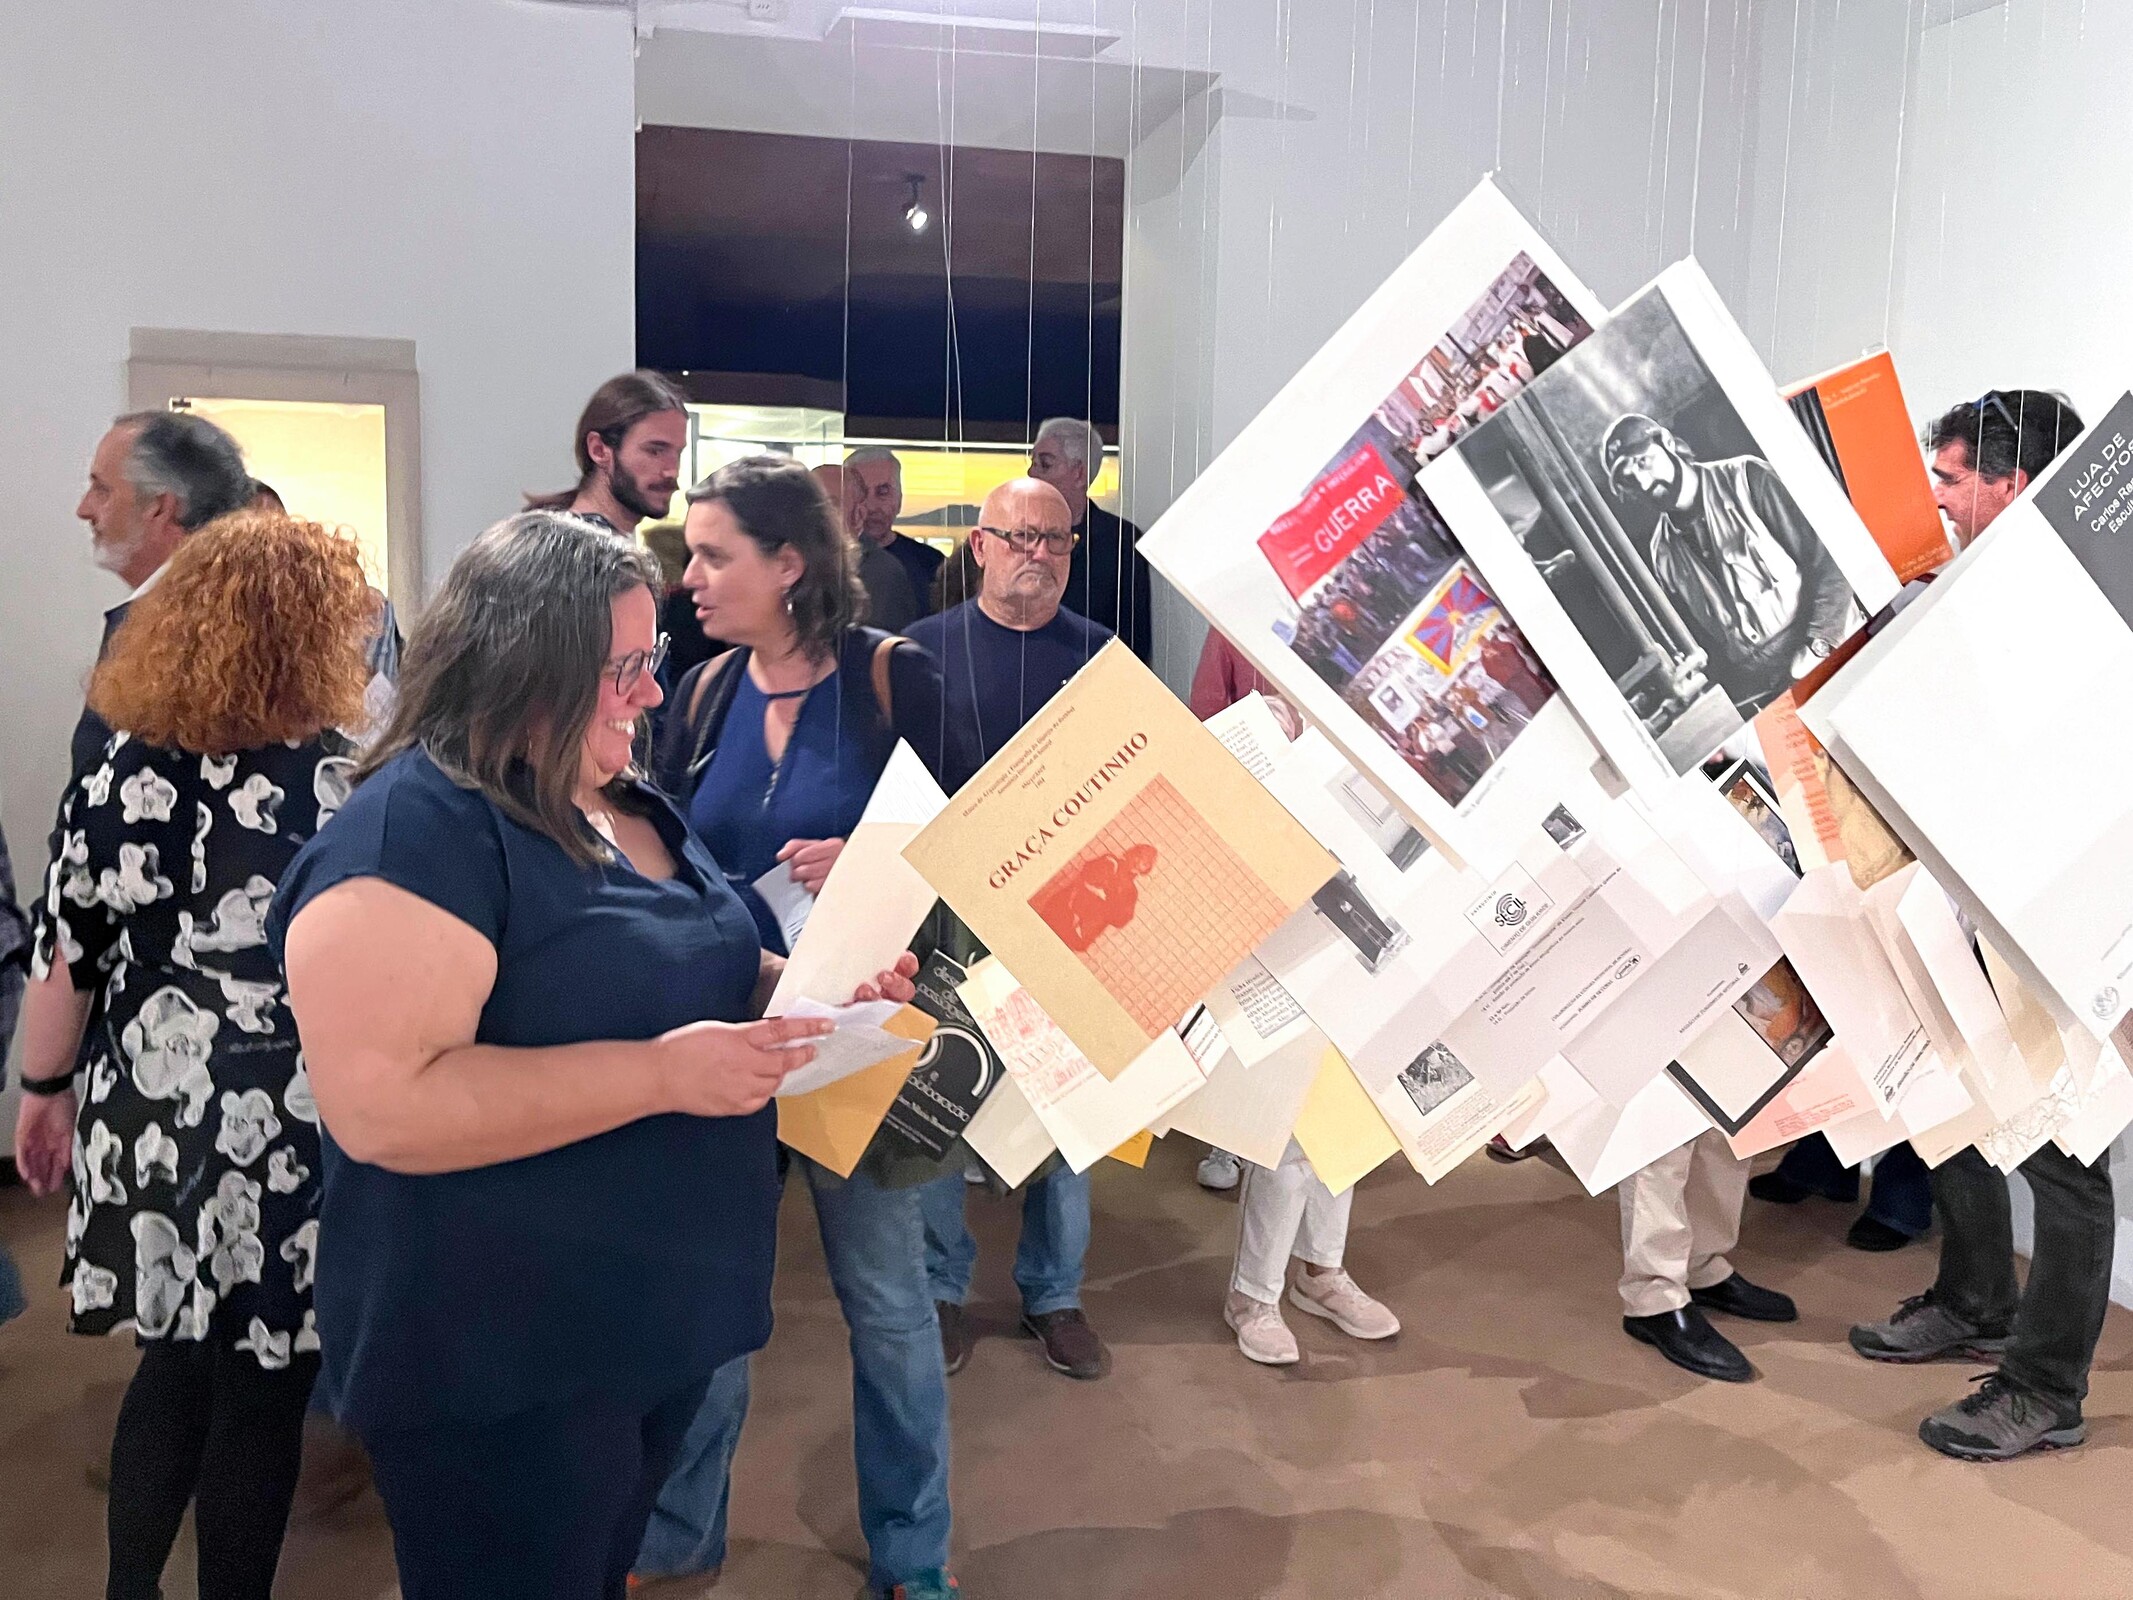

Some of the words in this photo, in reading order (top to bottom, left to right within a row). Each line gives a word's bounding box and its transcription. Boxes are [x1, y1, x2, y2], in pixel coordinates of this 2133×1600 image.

[2068, 462, 2104, 499] LUA
[2101, 432, 2126, 461] DE
[1313, 474, 1396, 553] GUERRA
[2090, 498, 2121, 532] Carlos
[989, 827, 1055, 889] GRAÇA
[1052, 732, 1148, 827] COUTINHO
[1494, 896, 1527, 927] SECIL
